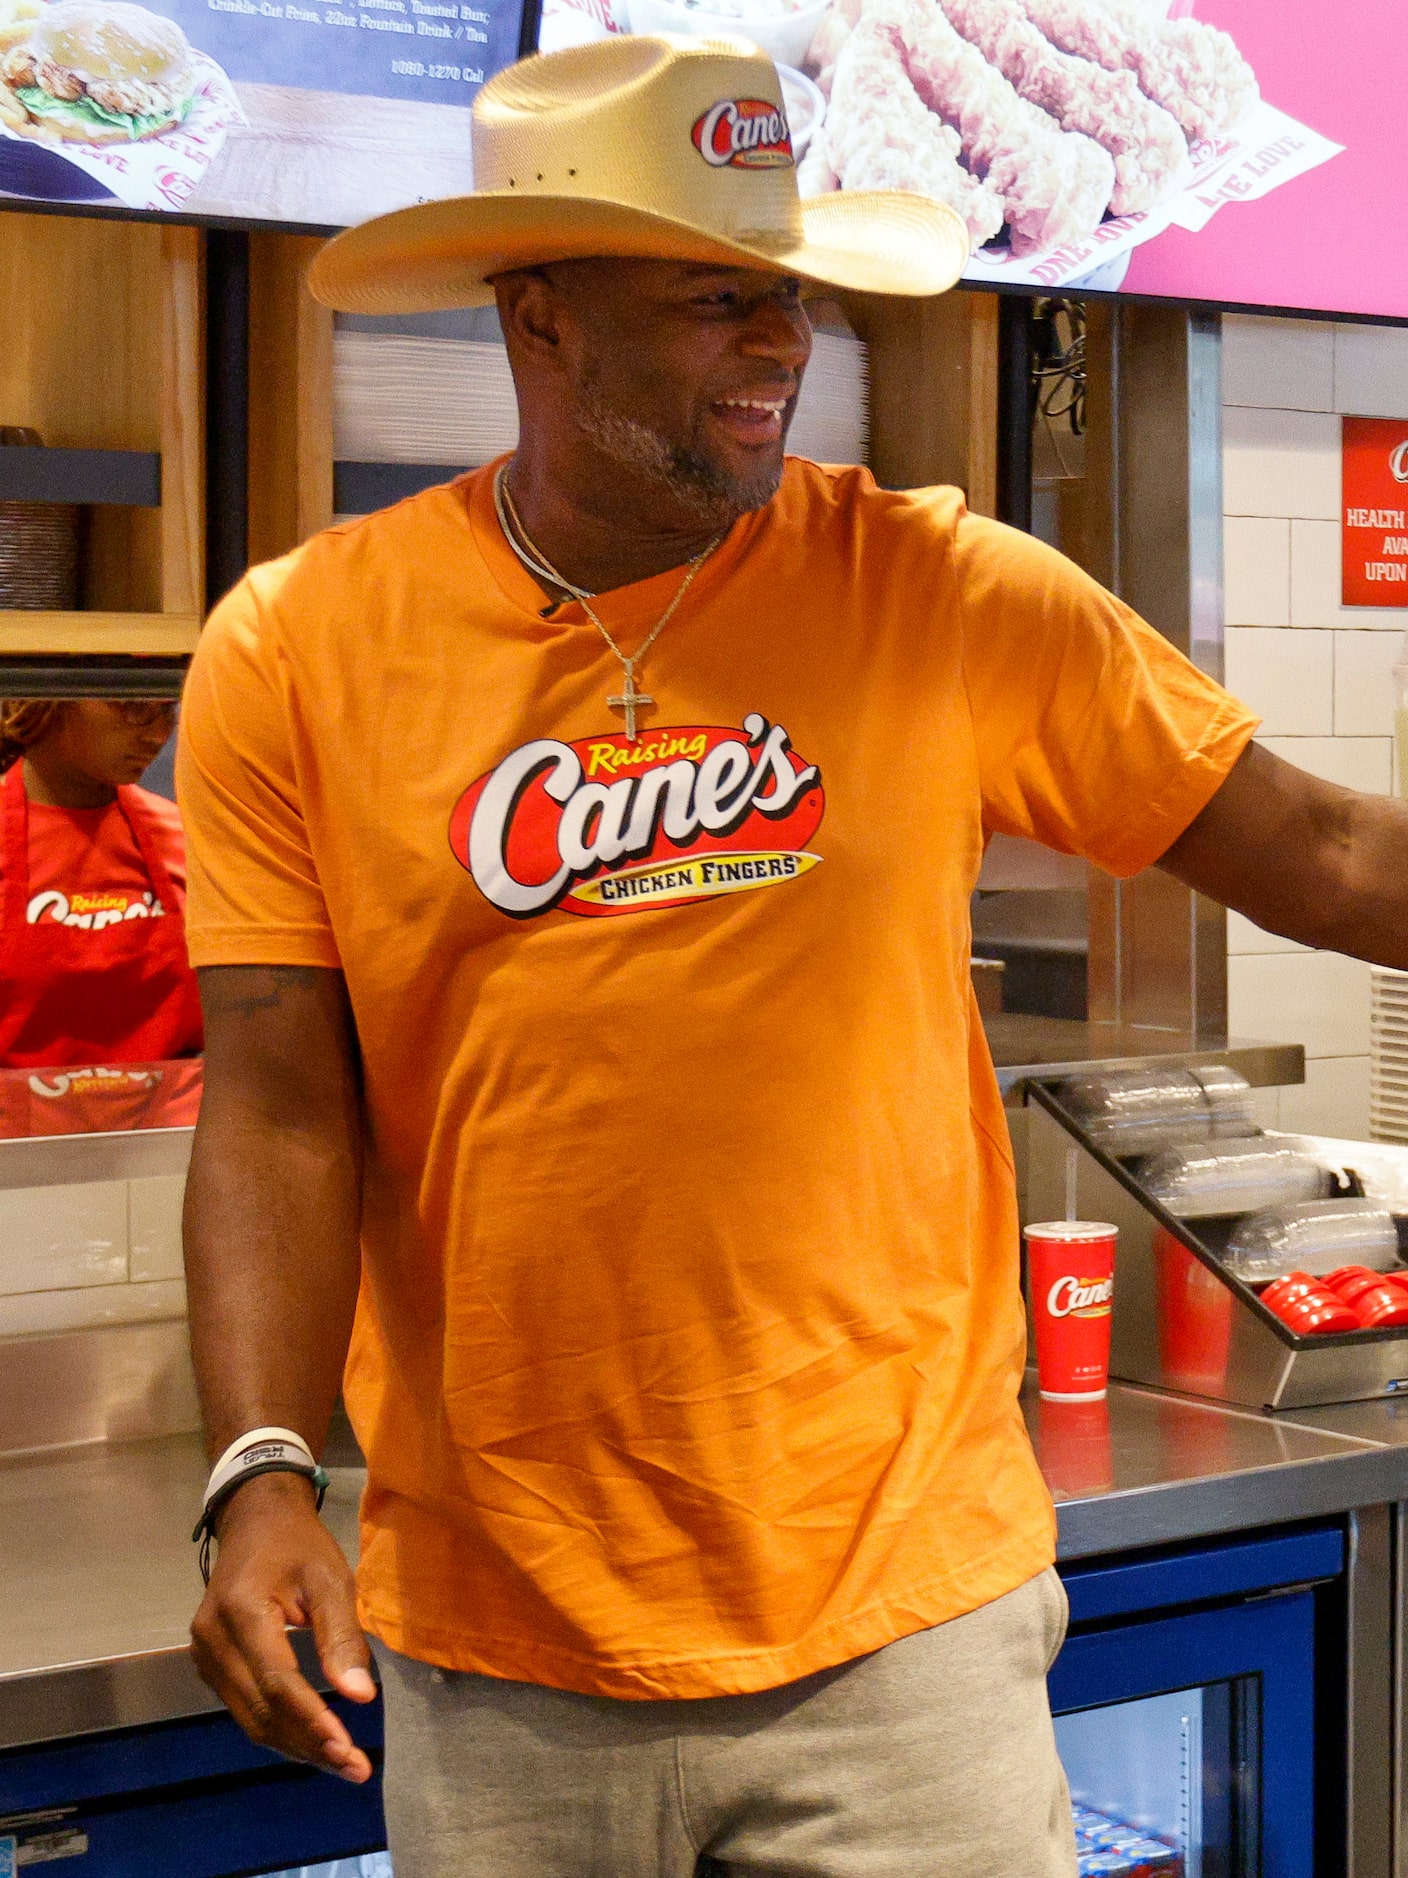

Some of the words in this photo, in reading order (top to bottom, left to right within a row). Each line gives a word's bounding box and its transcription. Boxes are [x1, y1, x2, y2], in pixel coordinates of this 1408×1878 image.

[360, 13, 415, 34] Fountain
[417, 20, 453, 38] Drink
[1347, 508, 1405, 529] HEALTH
[1365, 562, 1406, 582] UPON
[588, 734, 707, 776] Raising
[469, 713, 819, 915] Cane's
[600, 870, 693, 901] CHICKEN
[702, 856, 797, 884] FINGERS
[71, 894, 128, 912] Raising
